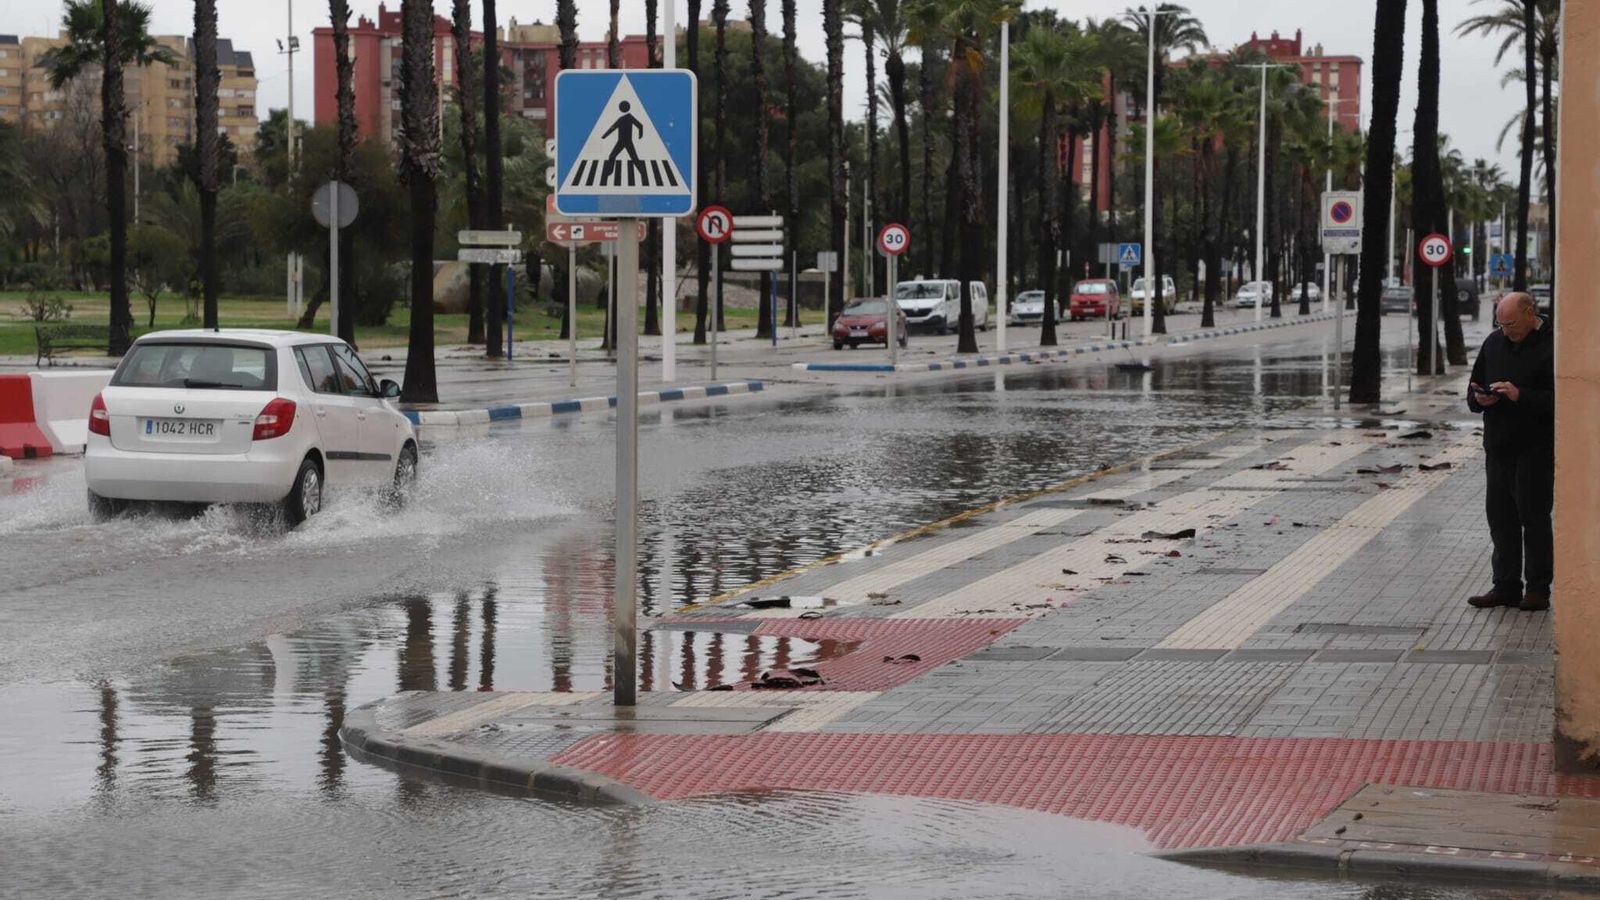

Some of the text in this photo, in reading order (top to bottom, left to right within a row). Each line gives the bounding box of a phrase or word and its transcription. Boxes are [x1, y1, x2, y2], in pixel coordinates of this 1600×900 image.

[886, 233, 903, 244] 30
[1426, 245, 1445, 255] 30
[156, 422, 185, 434] 1042
[189, 423, 214, 435] HCR
